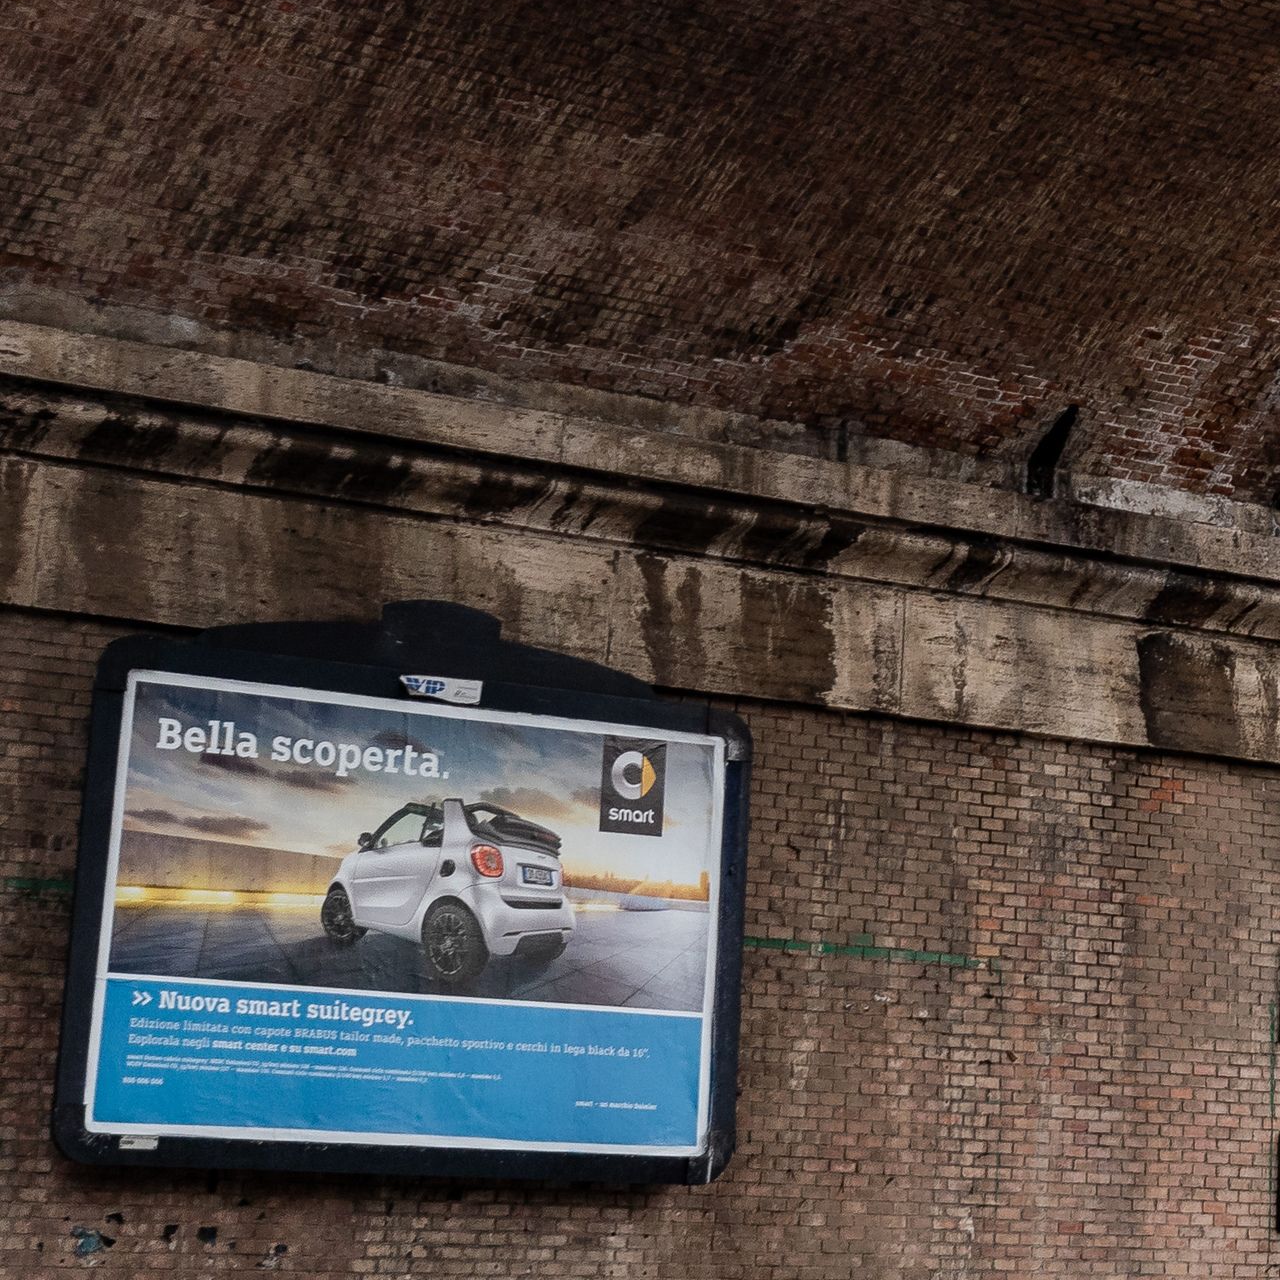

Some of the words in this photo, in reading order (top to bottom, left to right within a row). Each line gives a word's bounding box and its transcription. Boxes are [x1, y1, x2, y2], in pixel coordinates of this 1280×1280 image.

[156, 717, 259, 759] Bella
[271, 735, 450, 779] scoperta.
[608, 807, 655, 824] smart
[158, 990, 230, 1013] Nuova
[236, 998, 301, 1018] smart
[307, 1001, 414, 1028] suitegrey.
[129, 1018, 180, 1031] Edizione
[183, 1020, 229, 1033] limitata
[231, 1024, 252, 1035] con
[255, 1027, 292, 1038] capote
[294, 1028, 337, 1040] BRABUS
[340, 1030, 370, 1042] tailor
[407, 1036, 459, 1048] pacchetto
[462, 1039, 504, 1051] sportivo
[506, 1043, 514, 1051] e
[515, 1041, 547, 1053] cerchi
[550, 1044, 561, 1053] in
[563, 1043, 585, 1056] lega
[588, 1044, 615, 1056] black
[617, 1046, 630, 1057] da
[212, 1039, 243, 1050] smart
[245, 1041, 279, 1052] center
[280, 1044, 288, 1052] e
[289, 1044, 302, 1053] su
[303, 1045, 358, 1057] smart.com
